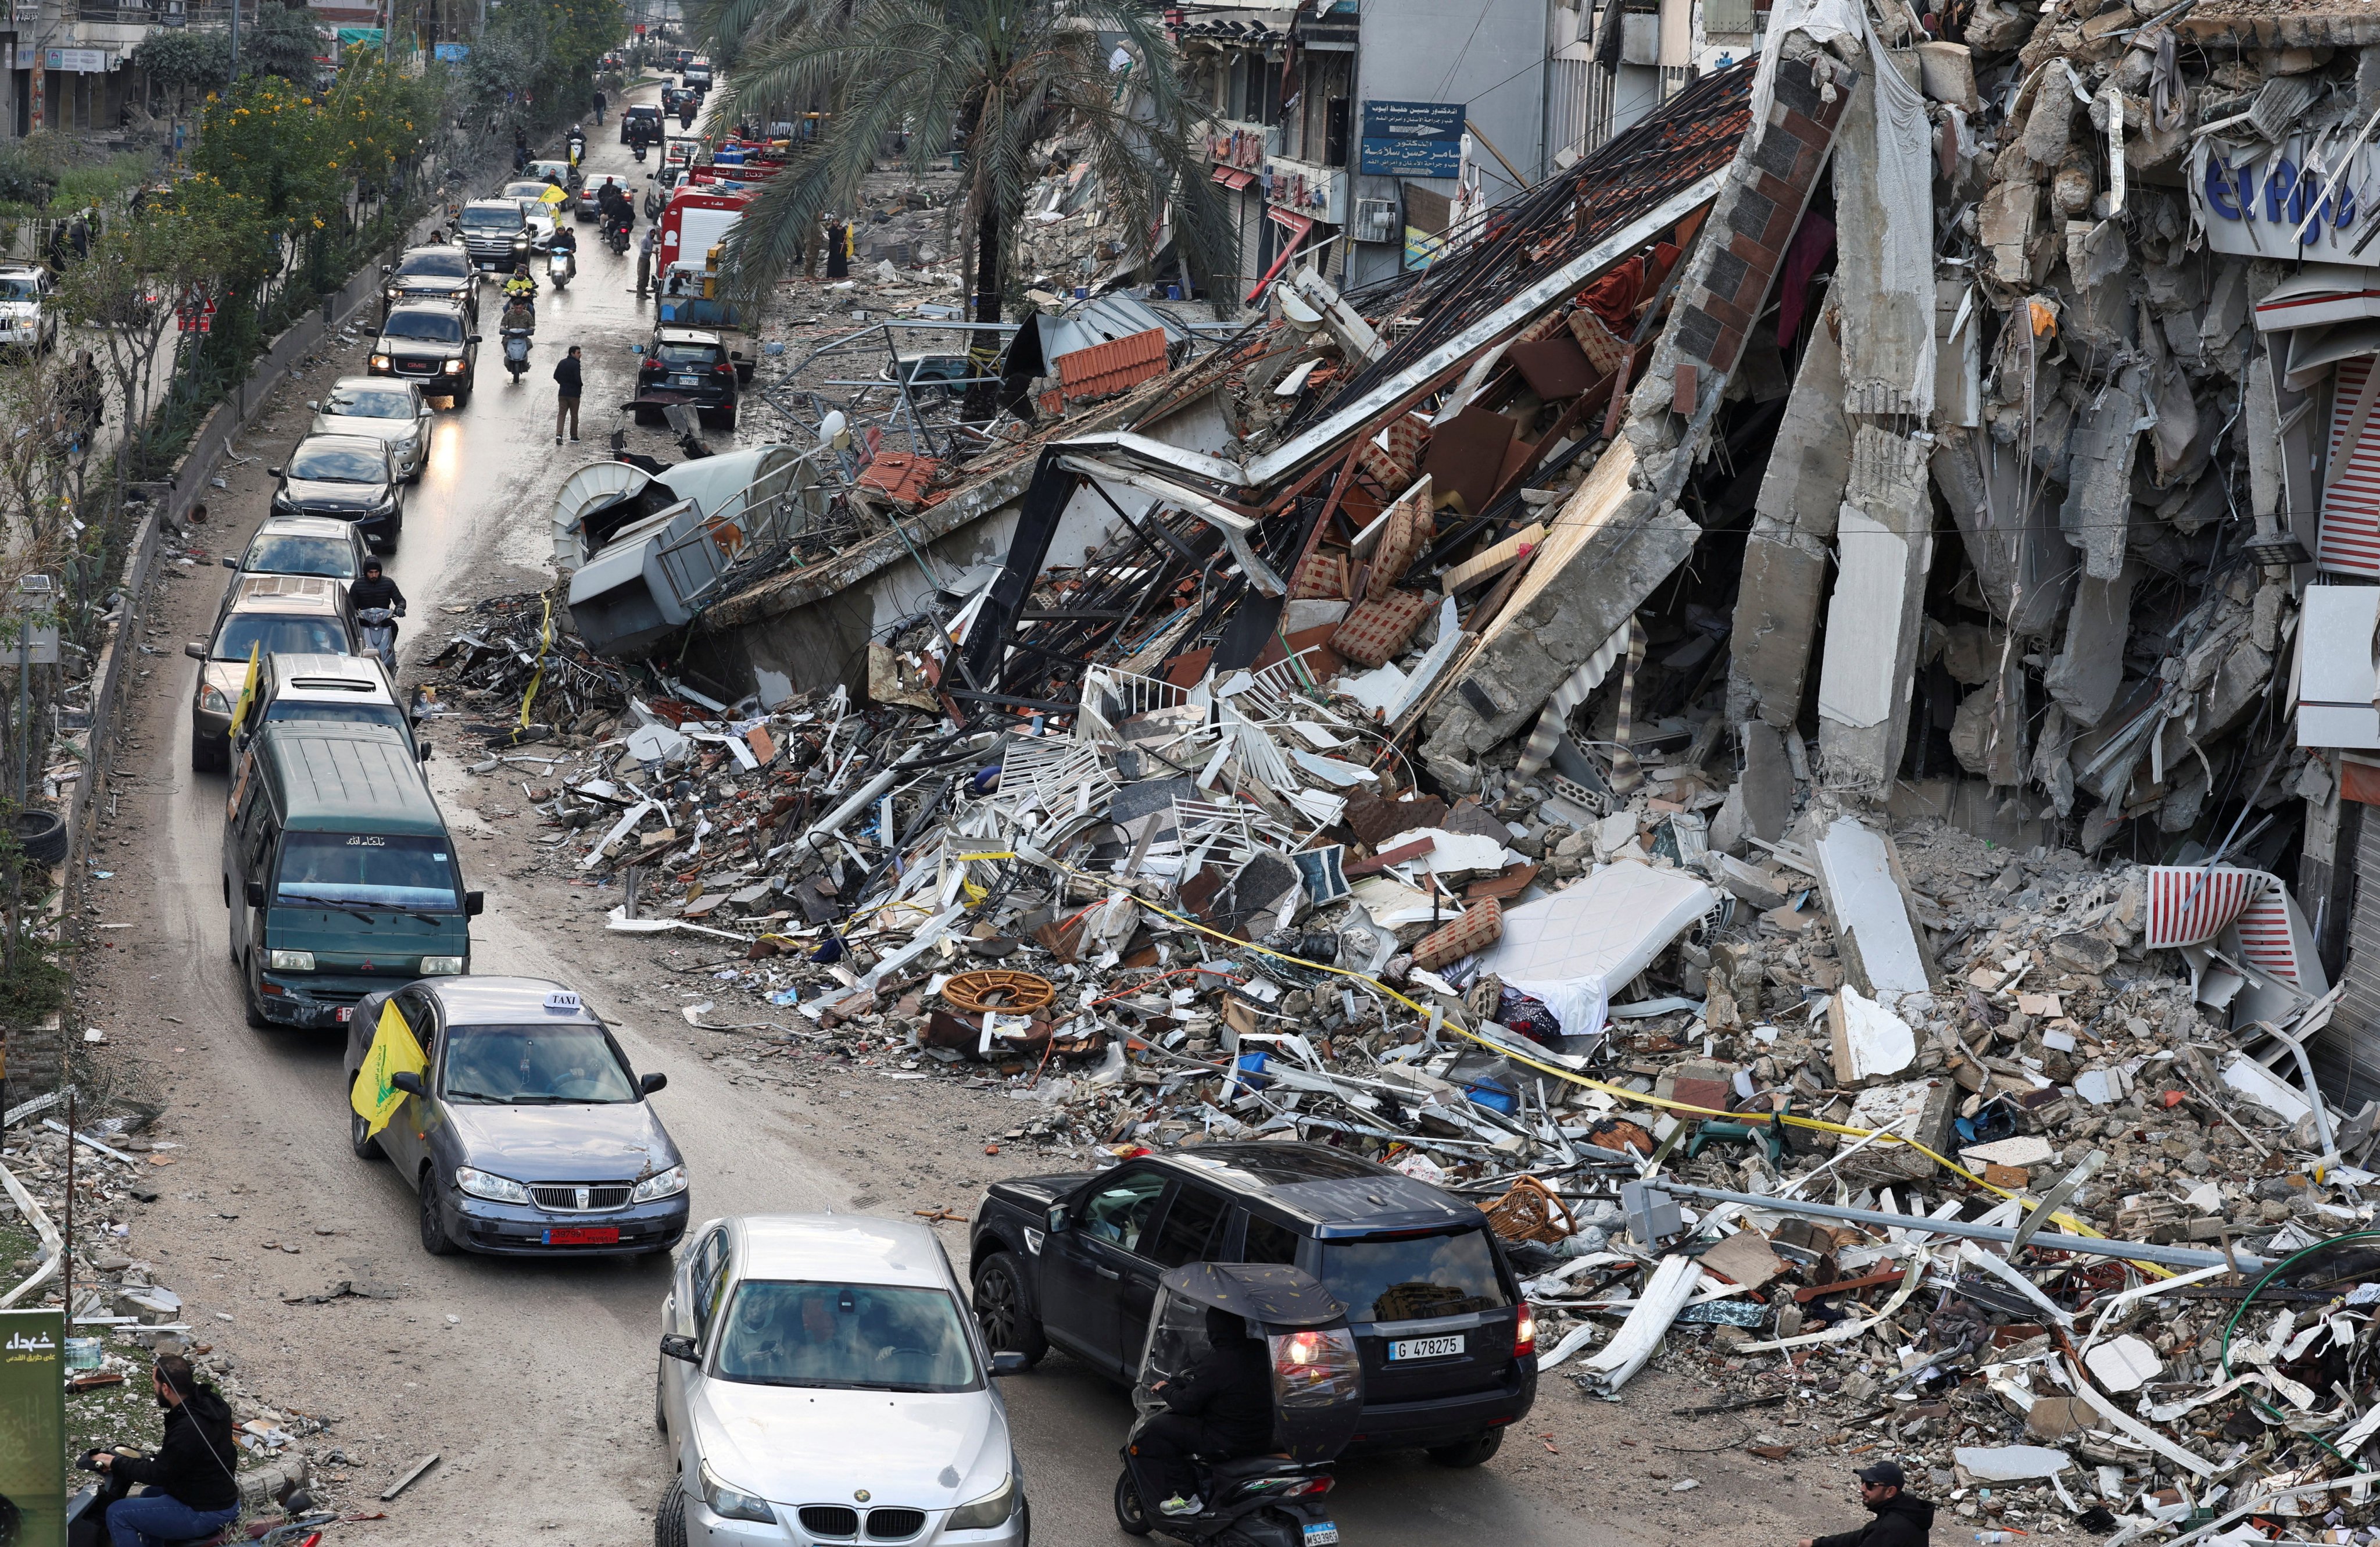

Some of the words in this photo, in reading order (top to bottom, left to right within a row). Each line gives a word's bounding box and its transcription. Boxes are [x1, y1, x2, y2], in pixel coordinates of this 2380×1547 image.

[1372, 103, 1388, 113] أيوب
[1390, 105, 1408, 113] حفيظ
[1364, 144, 1400, 156] سلامة
[1402, 148, 1427, 159] حسن
[1429, 149, 1461, 159] سامر
[553, 995, 576, 1005] TAXI
[6, 1331, 55, 1352] شهداء
[1399, 1343, 1406, 1357] G
[1414, 1338, 1456, 1356] 478275
[6, 1354, 26, 1363] القدس
[26, 1353, 42, 1362] طريق
[44, 1353, 56, 1362] على
[1307, 1531, 1338, 1546] M933969
